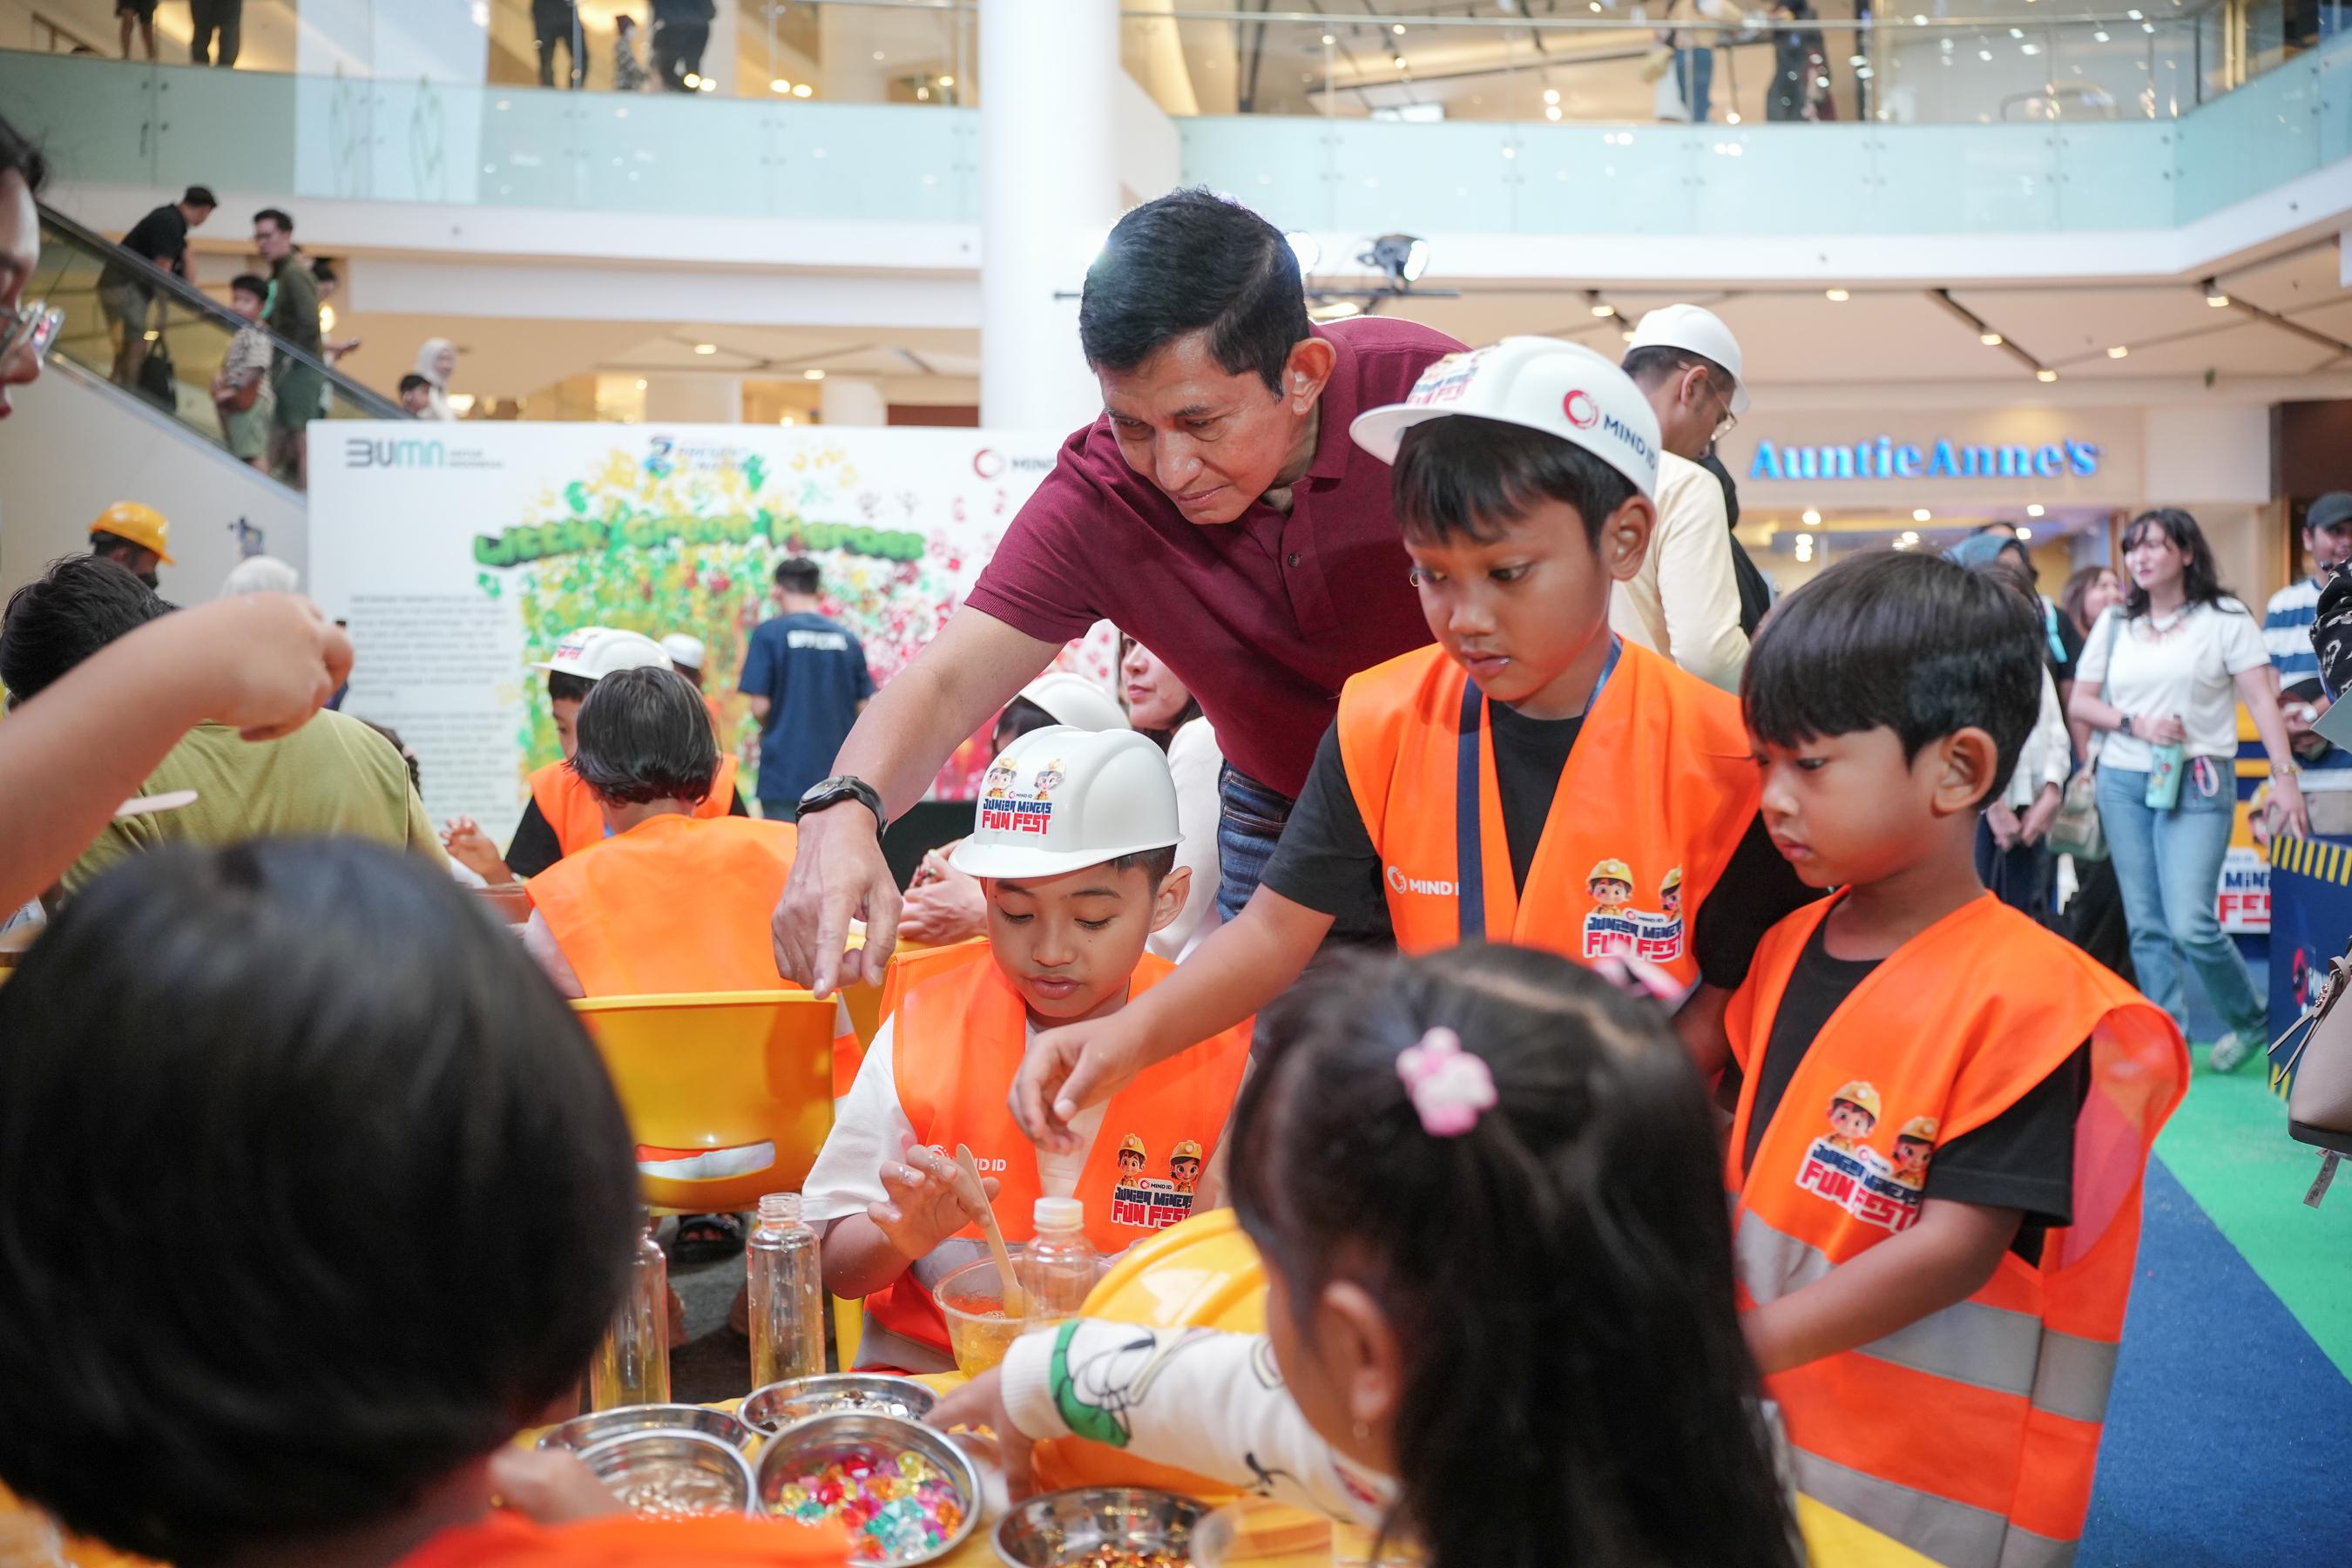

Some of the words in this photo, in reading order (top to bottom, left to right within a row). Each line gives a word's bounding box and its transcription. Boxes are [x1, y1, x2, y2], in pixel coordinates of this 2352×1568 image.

[1604, 414, 1646, 456] MIND
[1749, 436, 1922, 479] Auntie
[1926, 436, 2100, 477] Anne's
[983, 811, 1010, 830] FUN
[1012, 814, 1051, 835] FEST
[1409, 878, 1453, 895] MIND
[1802, 1159, 1855, 1203] FUN
[1113, 1201, 1145, 1225] FUN
